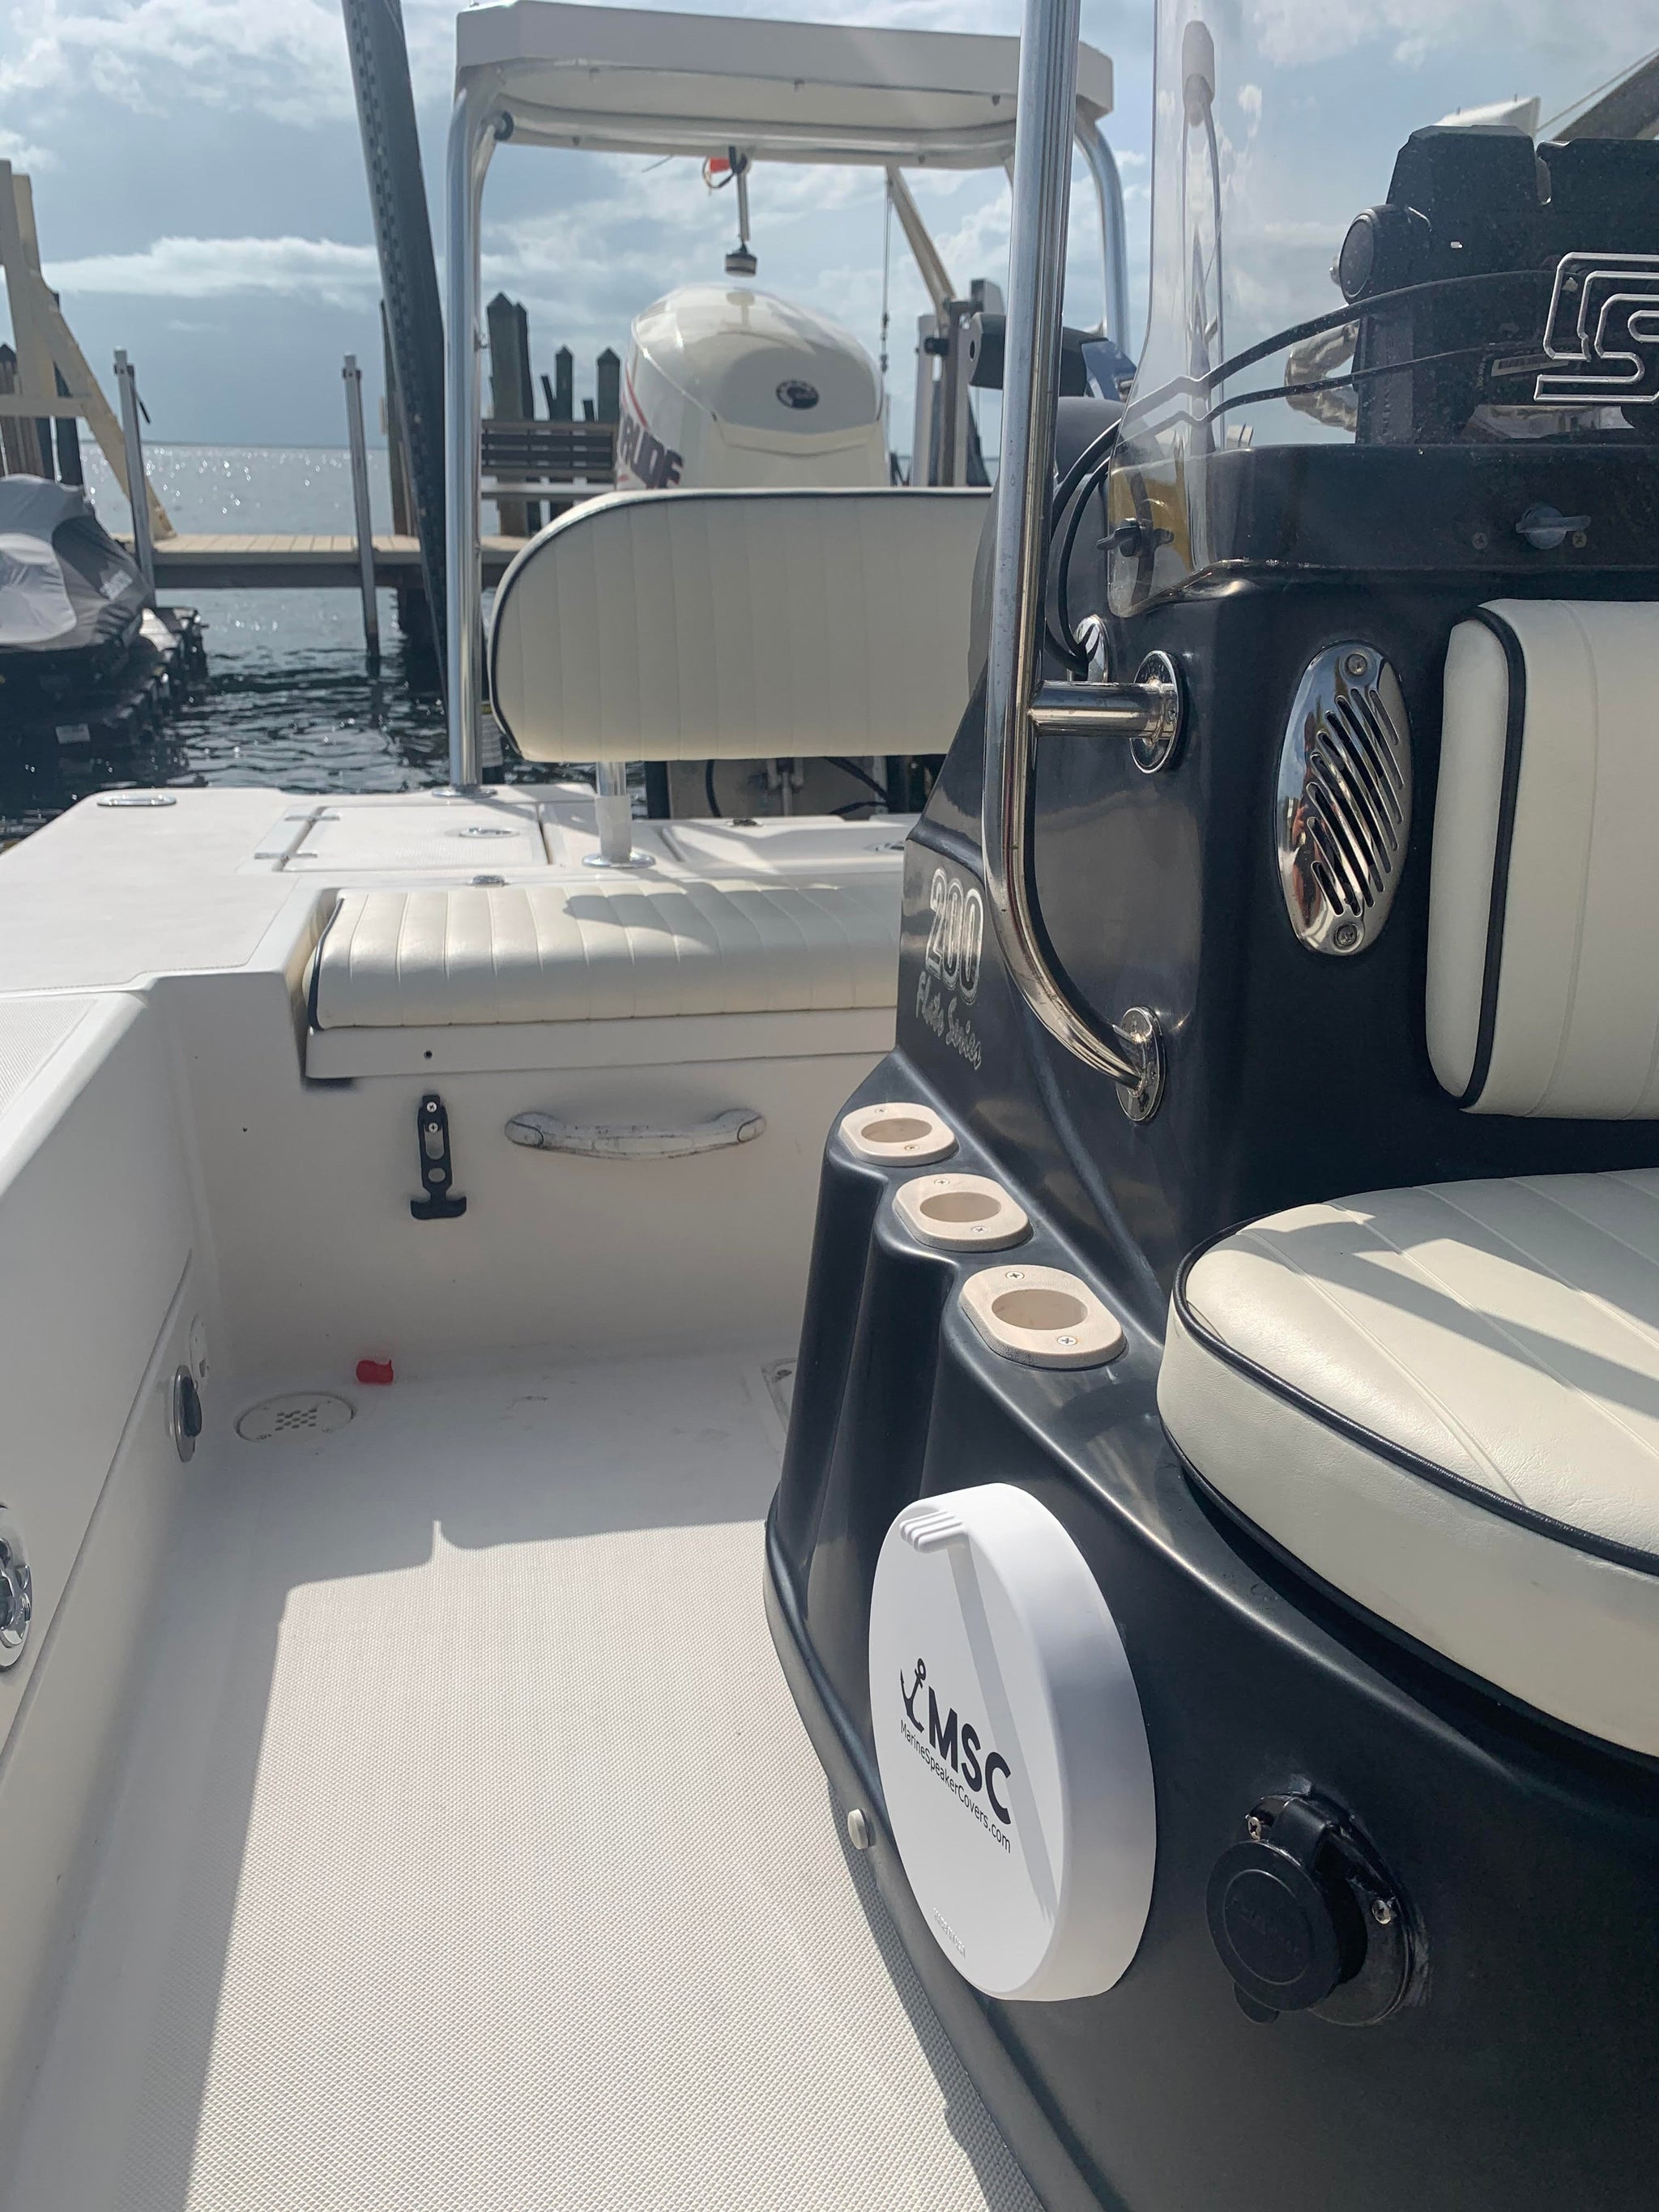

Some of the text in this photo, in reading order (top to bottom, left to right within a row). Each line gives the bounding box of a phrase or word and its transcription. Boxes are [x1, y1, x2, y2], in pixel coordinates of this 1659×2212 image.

[925, 867, 983, 1005] 200
[900, 1719, 1011, 1854] MarineSpeakerCovers.com
[928, 1685, 1011, 1825] MSC
